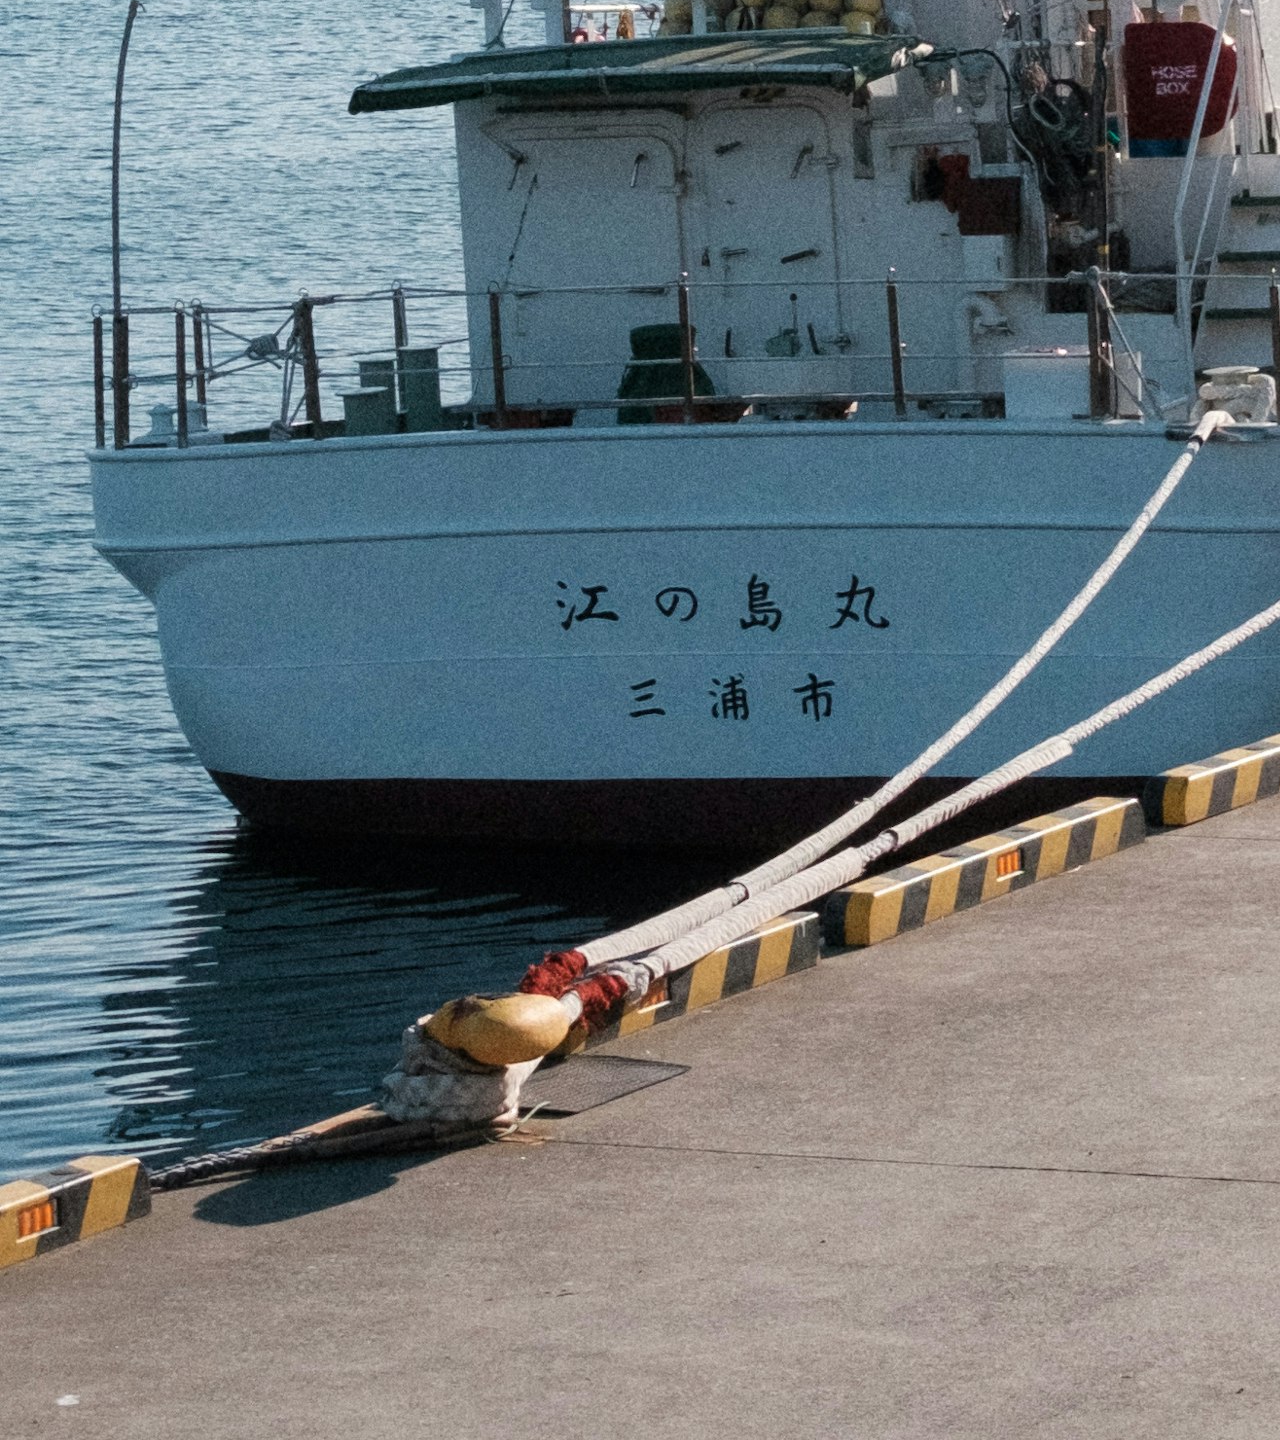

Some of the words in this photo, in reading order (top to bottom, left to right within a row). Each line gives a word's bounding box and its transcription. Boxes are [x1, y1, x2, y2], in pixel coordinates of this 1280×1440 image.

[1151, 65, 1197, 79] HOSE
[1156, 82, 1190, 96] BOX
[556, 574, 890, 631] 江の島丸
[629, 673, 835, 722] 三浦市
